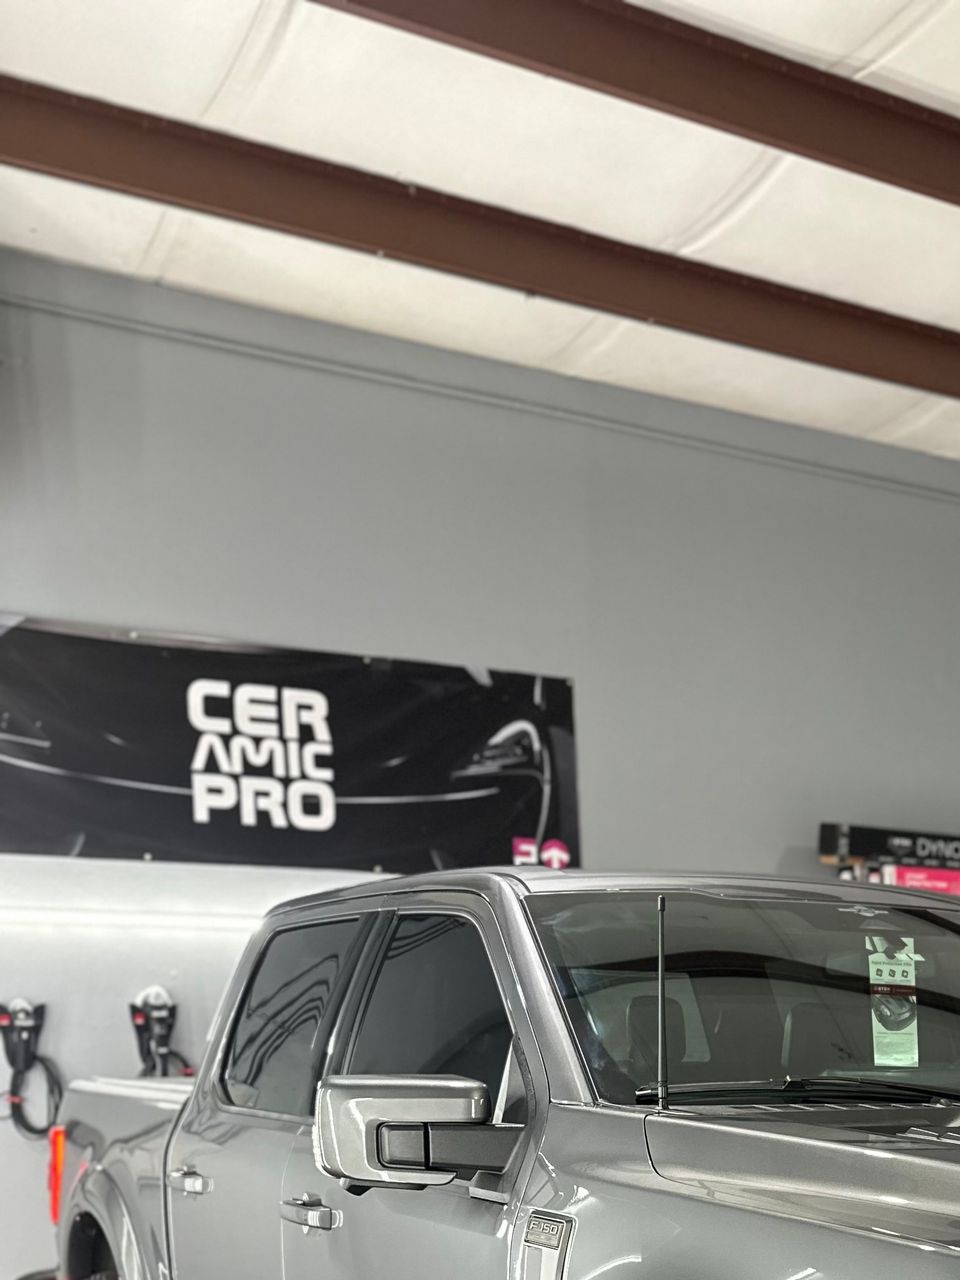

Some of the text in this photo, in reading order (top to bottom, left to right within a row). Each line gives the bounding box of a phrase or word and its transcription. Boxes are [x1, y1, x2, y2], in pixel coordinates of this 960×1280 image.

[187, 679, 331, 742] CER
[190, 733, 335, 782] AMIC
[191, 773, 336, 831] PRO
